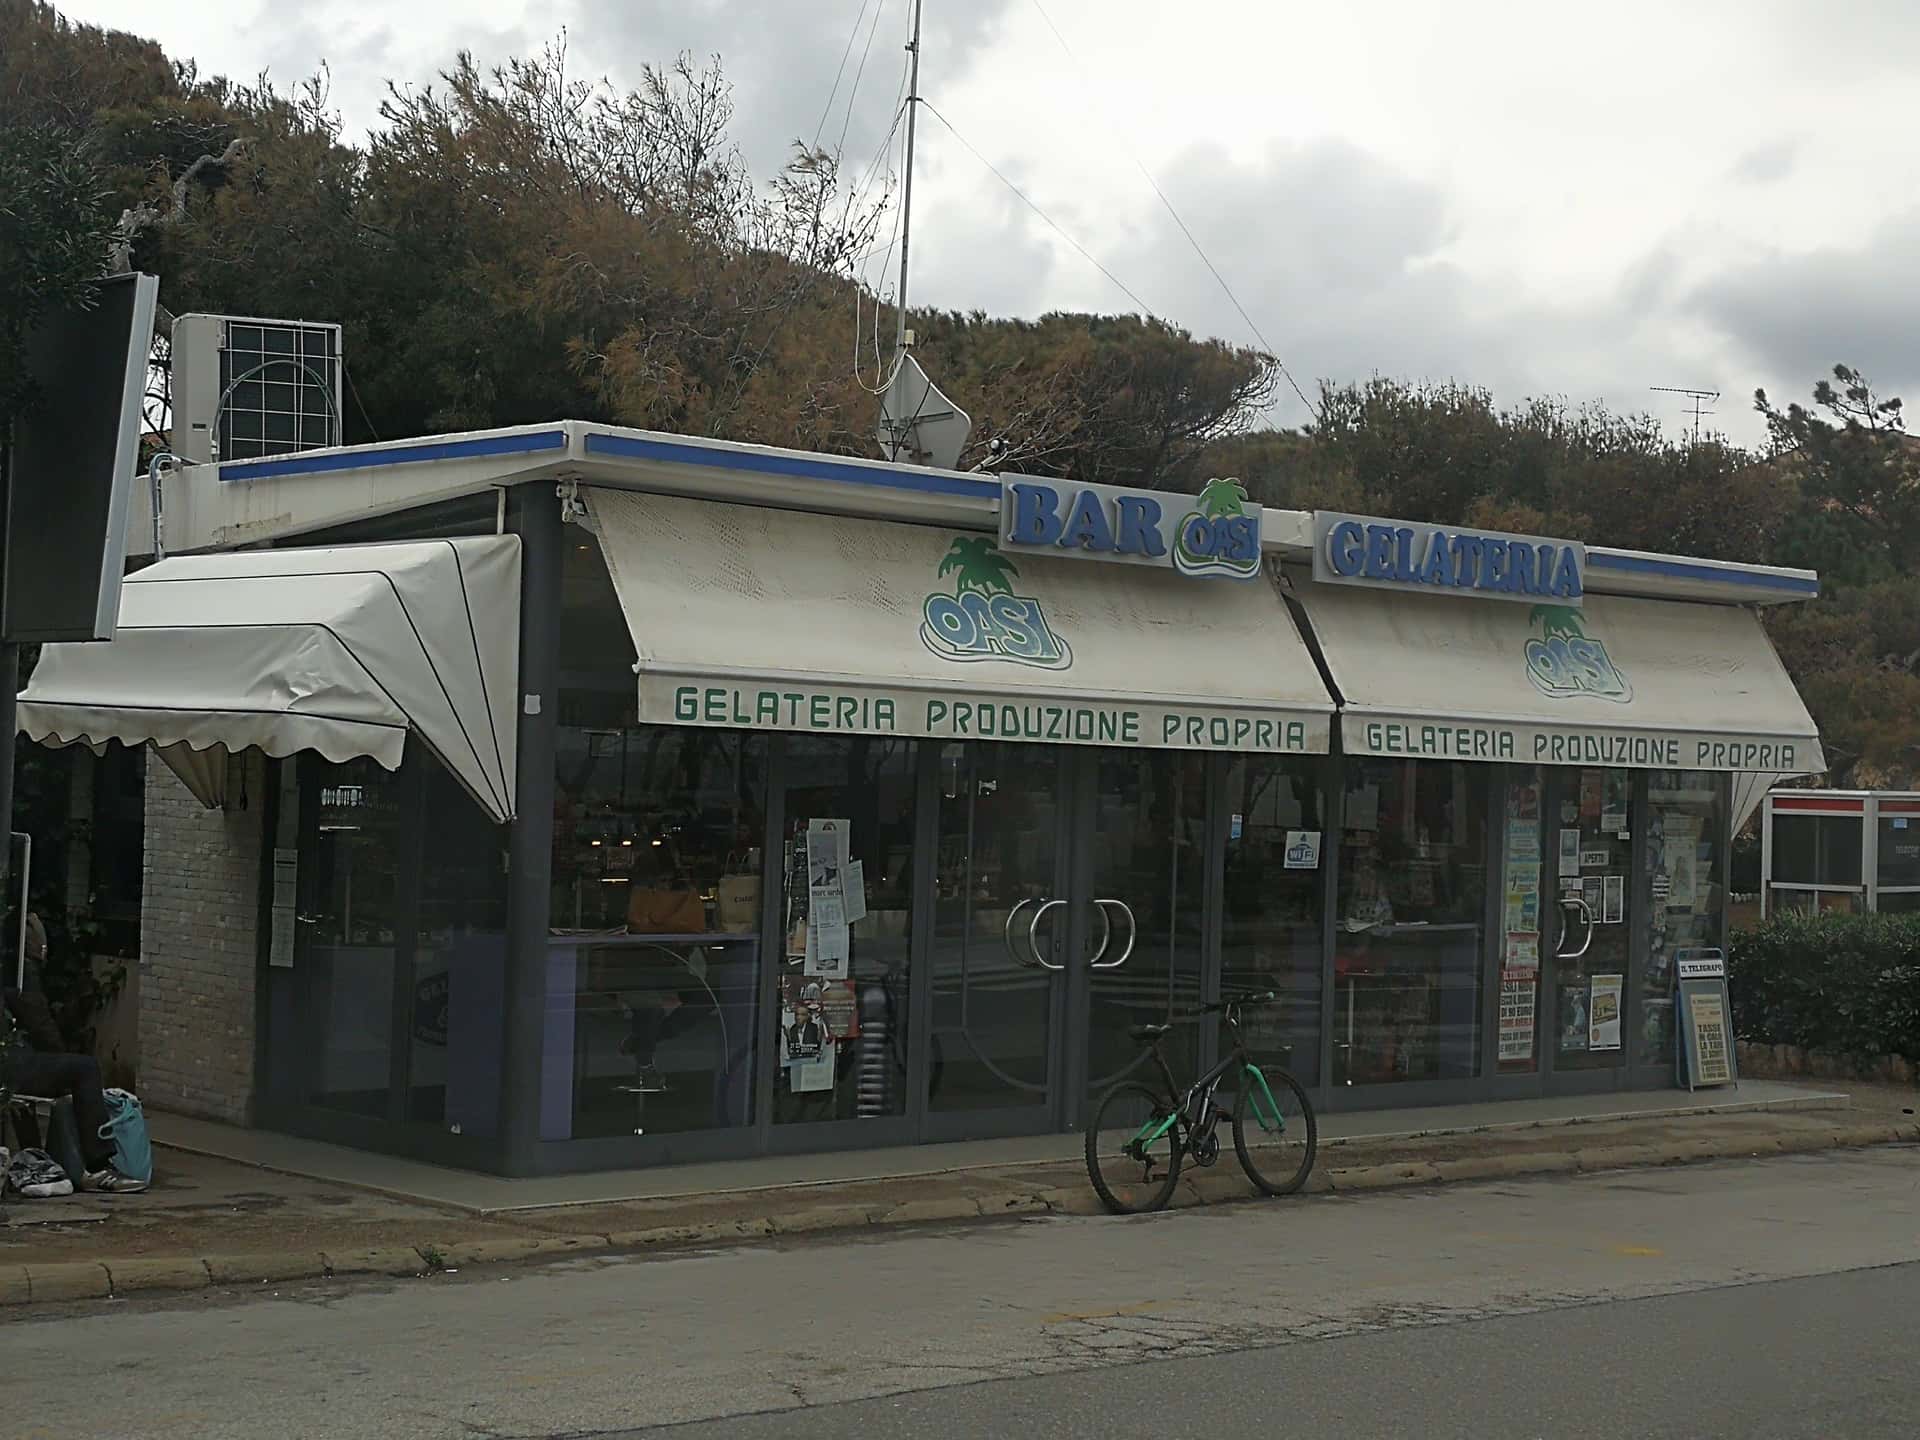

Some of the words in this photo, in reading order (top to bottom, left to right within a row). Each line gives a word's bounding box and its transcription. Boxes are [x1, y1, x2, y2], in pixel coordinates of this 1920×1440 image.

[1008, 482, 1168, 557] BAR
[1186, 513, 1259, 560] OASI
[1326, 519, 1584, 598] GELATERIA
[923, 590, 1063, 660] OASI
[1524, 633, 1625, 694] OASI
[674, 686, 896, 731] GELATERIA
[926, 699, 1140, 742] PRODUZIONE
[1163, 713, 1305, 750] PROPRIA
[1367, 722, 1514, 758] GELATERIA
[1534, 733, 1680, 765] PRODUZIONE
[1696, 741, 1795, 769] PROPRIA
